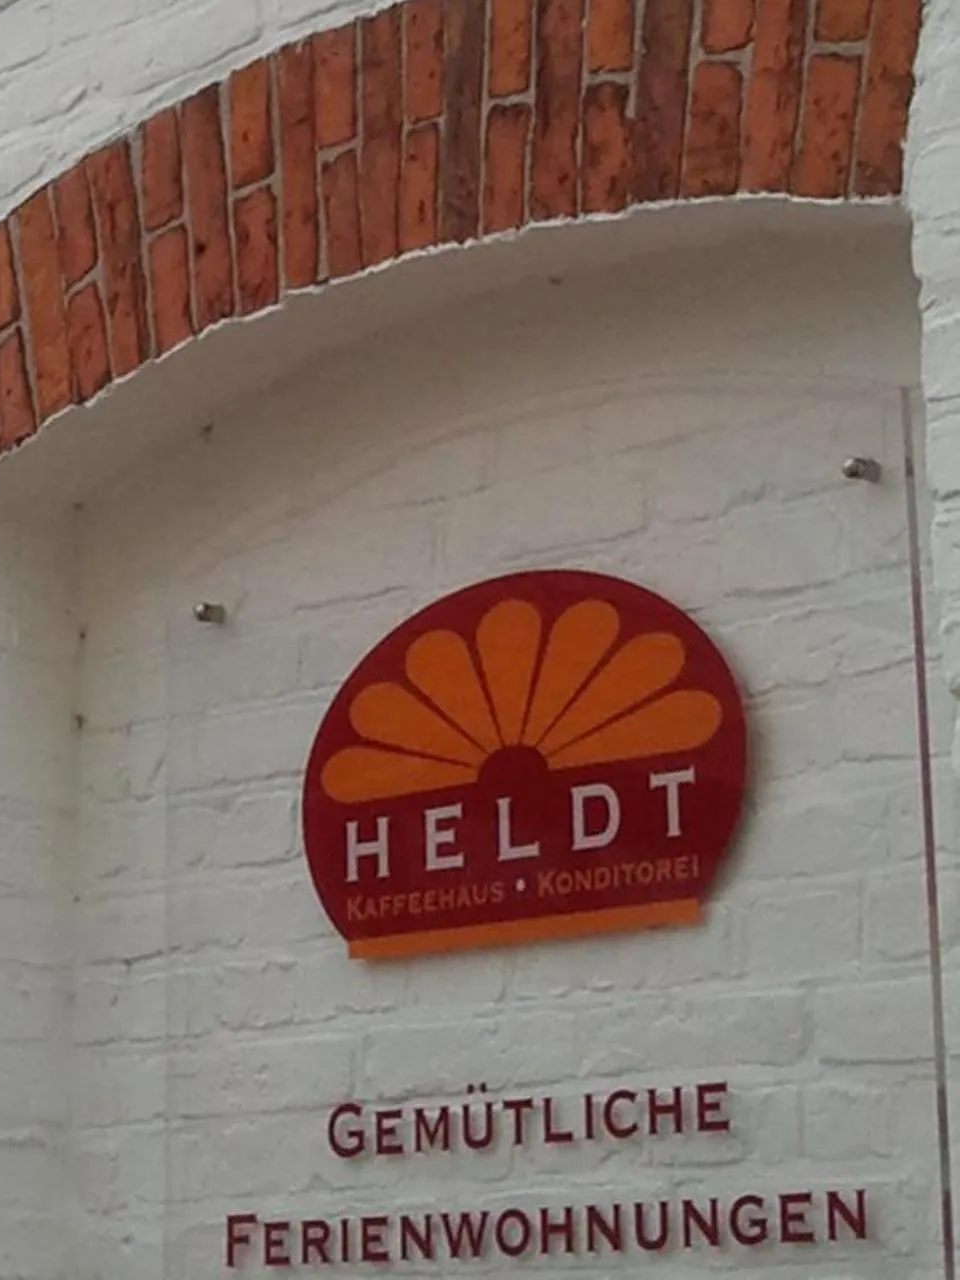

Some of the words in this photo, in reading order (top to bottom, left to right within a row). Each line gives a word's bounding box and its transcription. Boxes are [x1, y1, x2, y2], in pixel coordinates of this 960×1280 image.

[344, 767, 696, 882] HELDT
[346, 881, 506, 921] KAFFEEHAUS
[537, 854, 700, 900] KONDITOREI
[327, 1082, 732, 1158] GEMÜTLICHE
[224, 1188, 869, 1268] FERIENWOHNUNGEN
